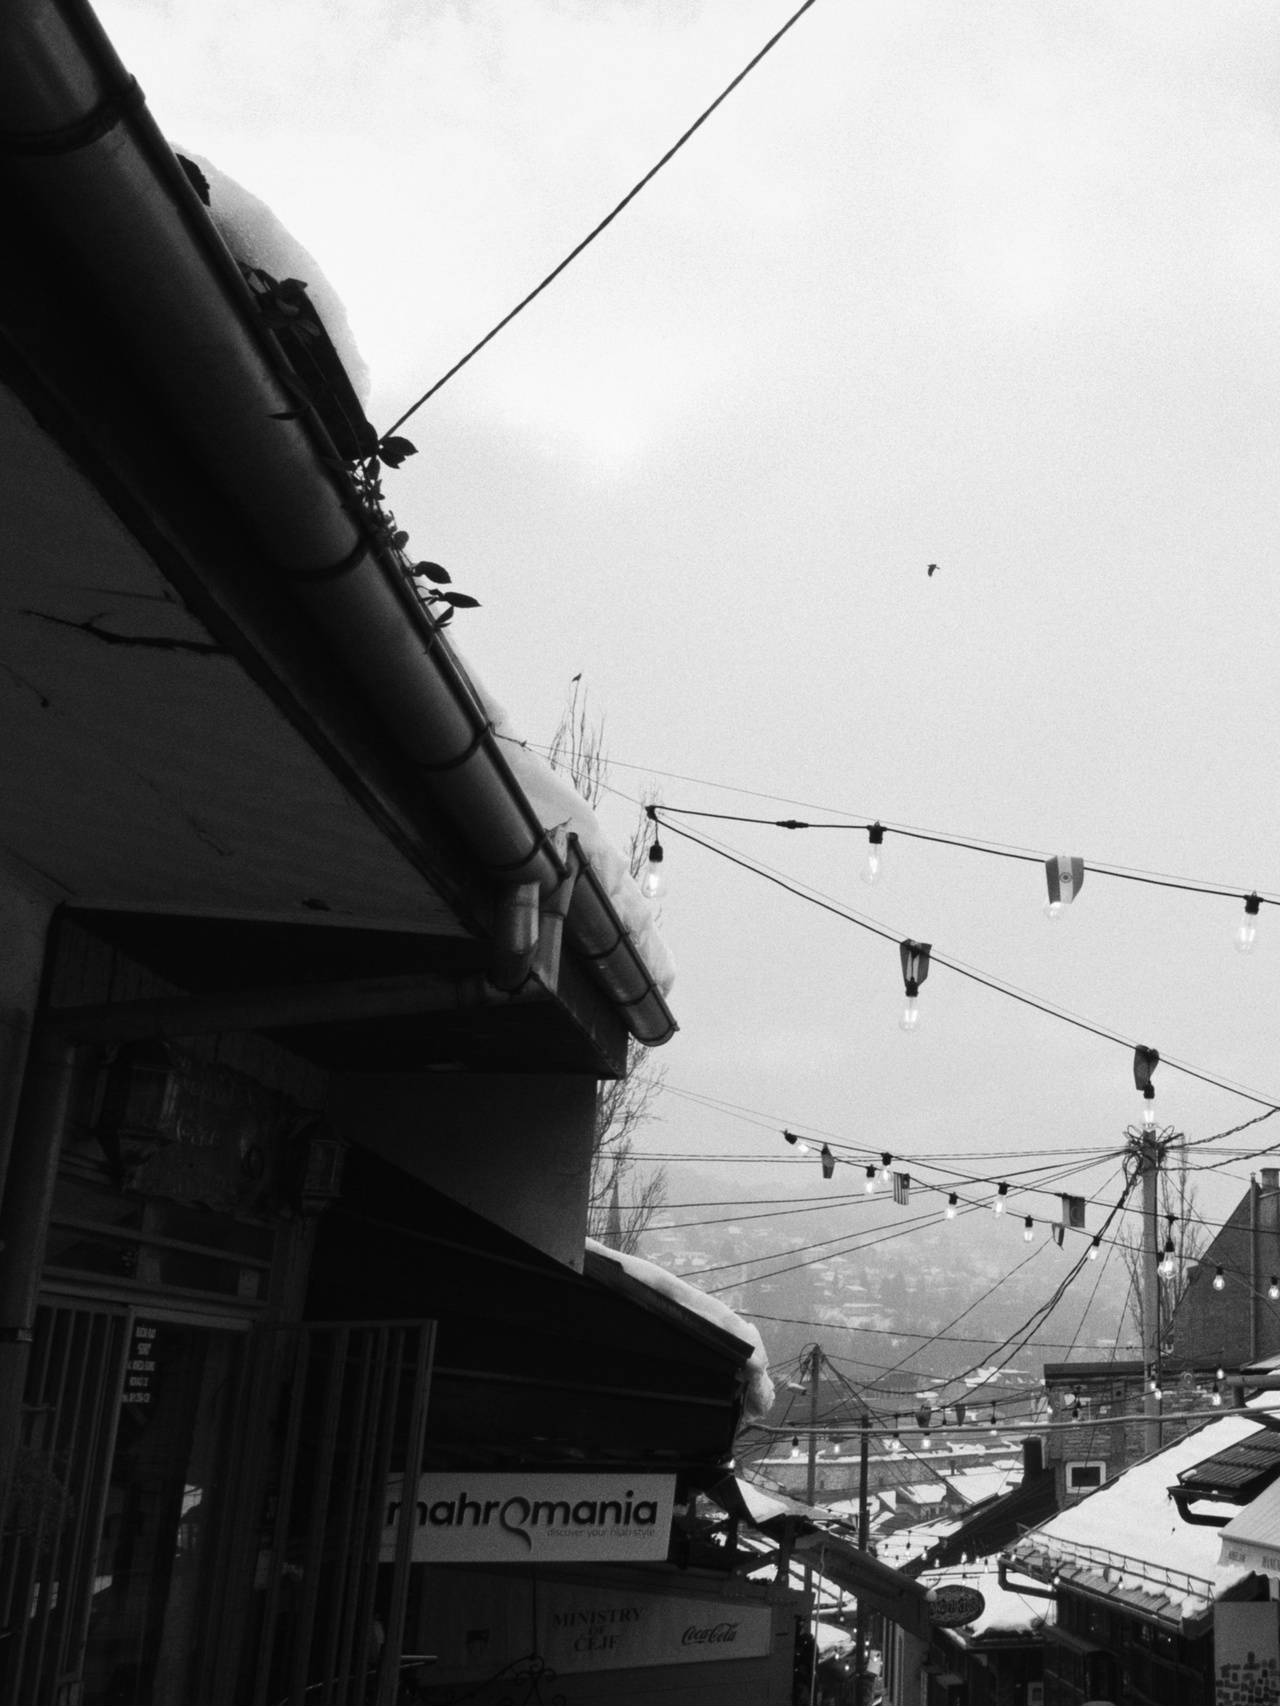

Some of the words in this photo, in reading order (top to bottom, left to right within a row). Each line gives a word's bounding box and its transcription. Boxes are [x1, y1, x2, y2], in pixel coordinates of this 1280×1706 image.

[547, 1527, 584, 1537] discover
[587, 1529, 608, 1539] your
[633, 1527, 656, 1539] style
[552, 1607, 642, 1627] MINISTRY
[588, 1624, 607, 1637] OF
